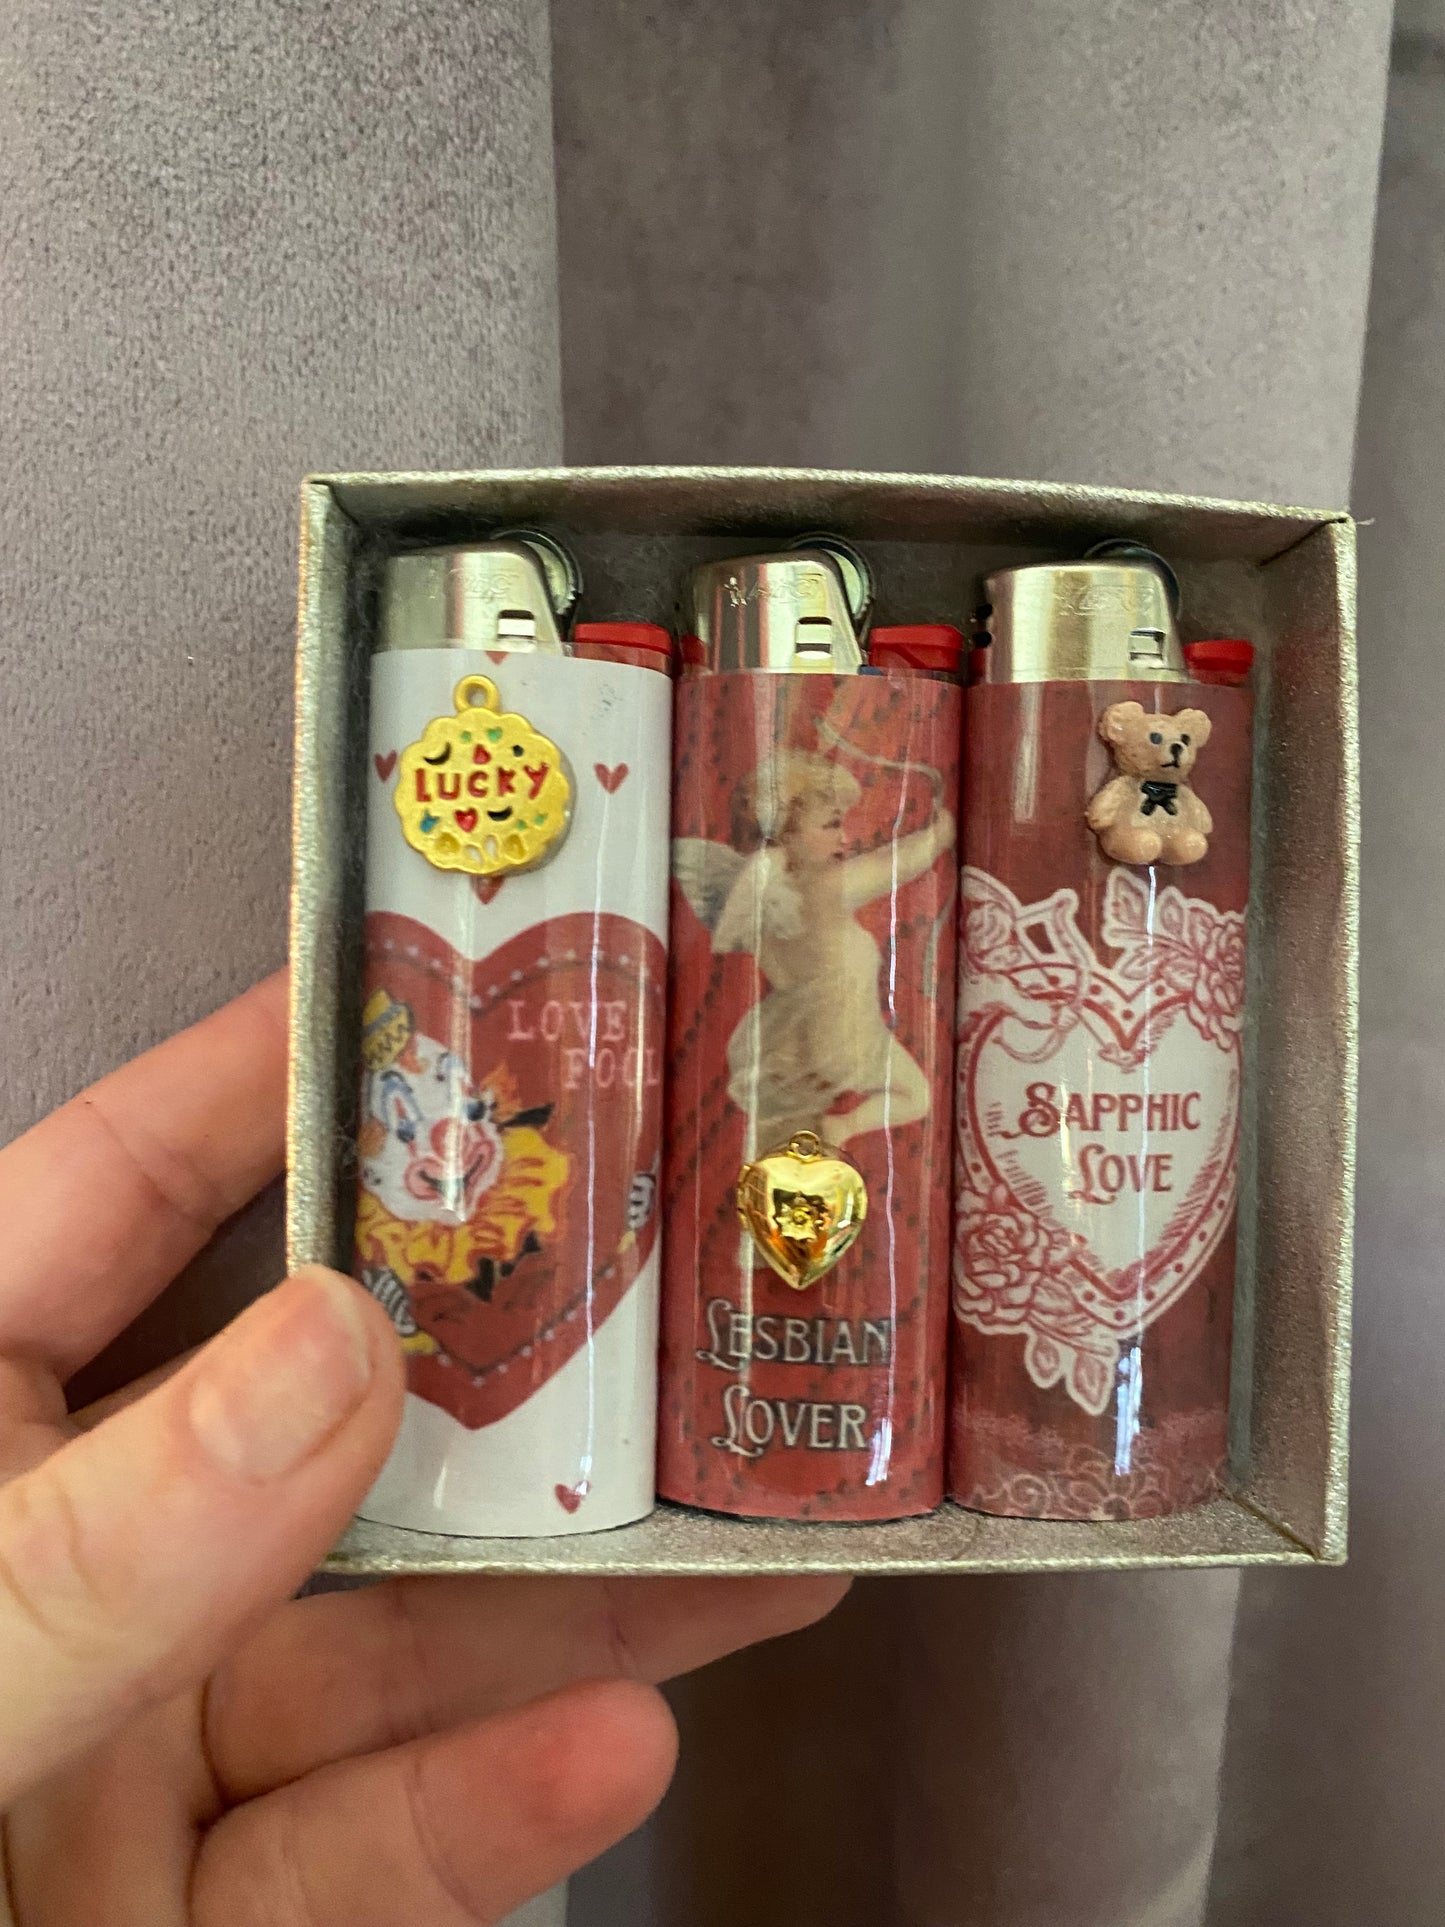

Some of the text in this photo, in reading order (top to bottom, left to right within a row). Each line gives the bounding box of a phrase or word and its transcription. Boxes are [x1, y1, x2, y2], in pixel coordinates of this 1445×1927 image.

[414, 761, 550, 803] LUCKY
[507, 999, 627, 1042] LOVE
[1004, 1081, 1201, 1139] SAPPHIC
[1067, 1143, 1173, 1205] LOVE
[694, 1297, 891, 1372] LESBIAN
[710, 1384, 868, 1458] LOVER
